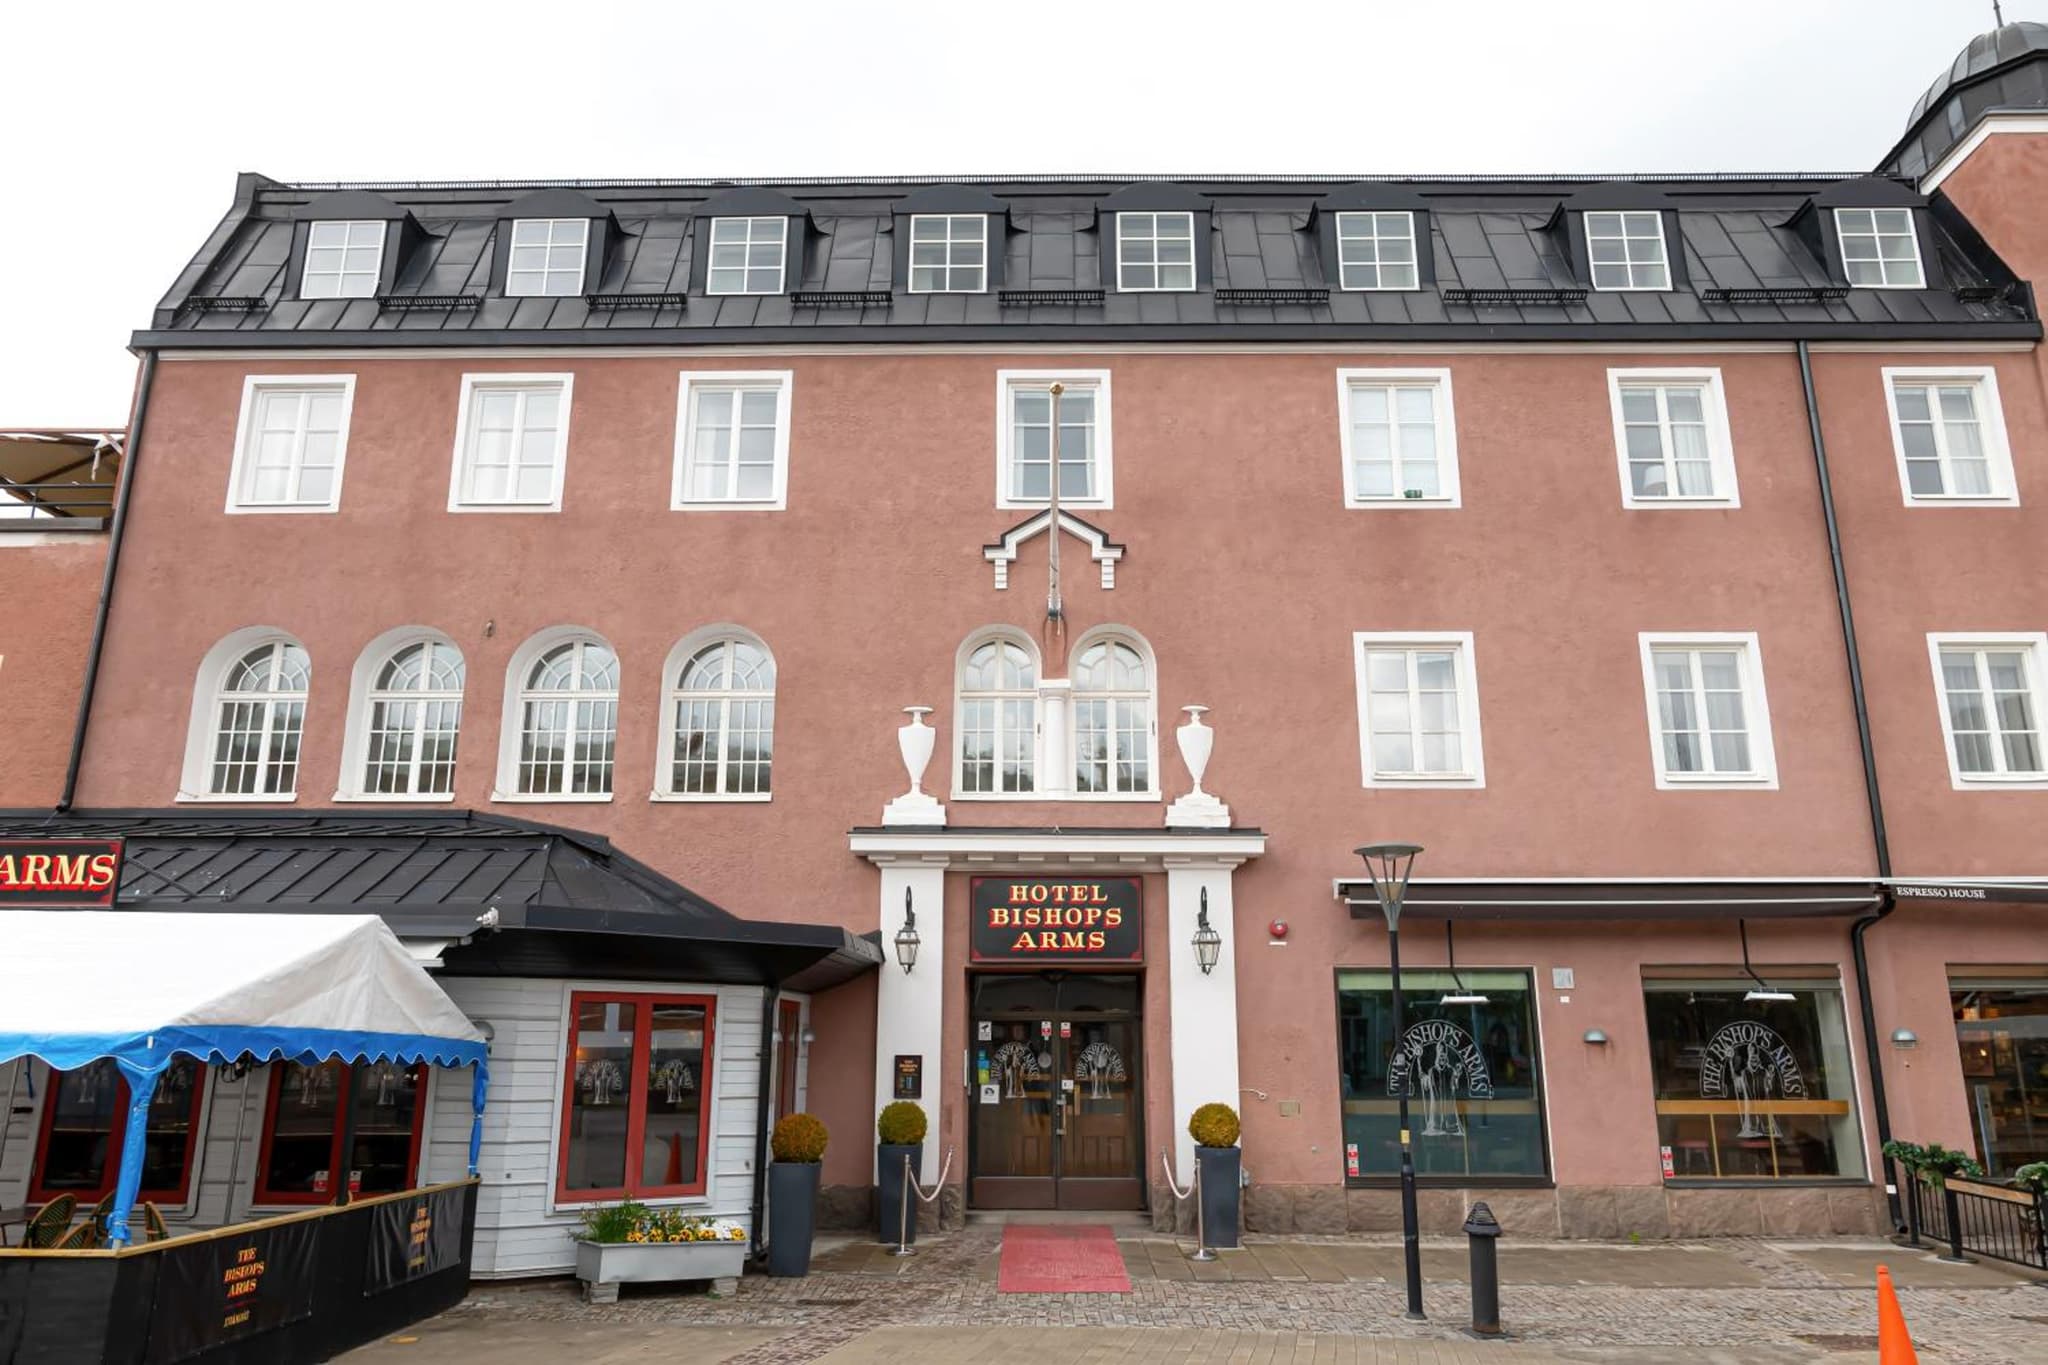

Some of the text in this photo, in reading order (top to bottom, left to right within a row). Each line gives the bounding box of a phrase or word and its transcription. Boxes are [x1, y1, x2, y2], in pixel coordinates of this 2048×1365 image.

[0, 854, 116, 891] ARMS
[1009, 884, 1108, 904] HOTEL
[1896, 886, 1986, 899] ESPRESSO HOUSE
[989, 907, 1122, 928] BISHOPS
[1011, 931, 1106, 951] ARMS
[1403, 1022, 1462, 1061] BISHOPS
[1459, 1043, 1488, 1092] ARMS
[1703, 1024, 1801, 1094] THE BISHOPS ARMS
